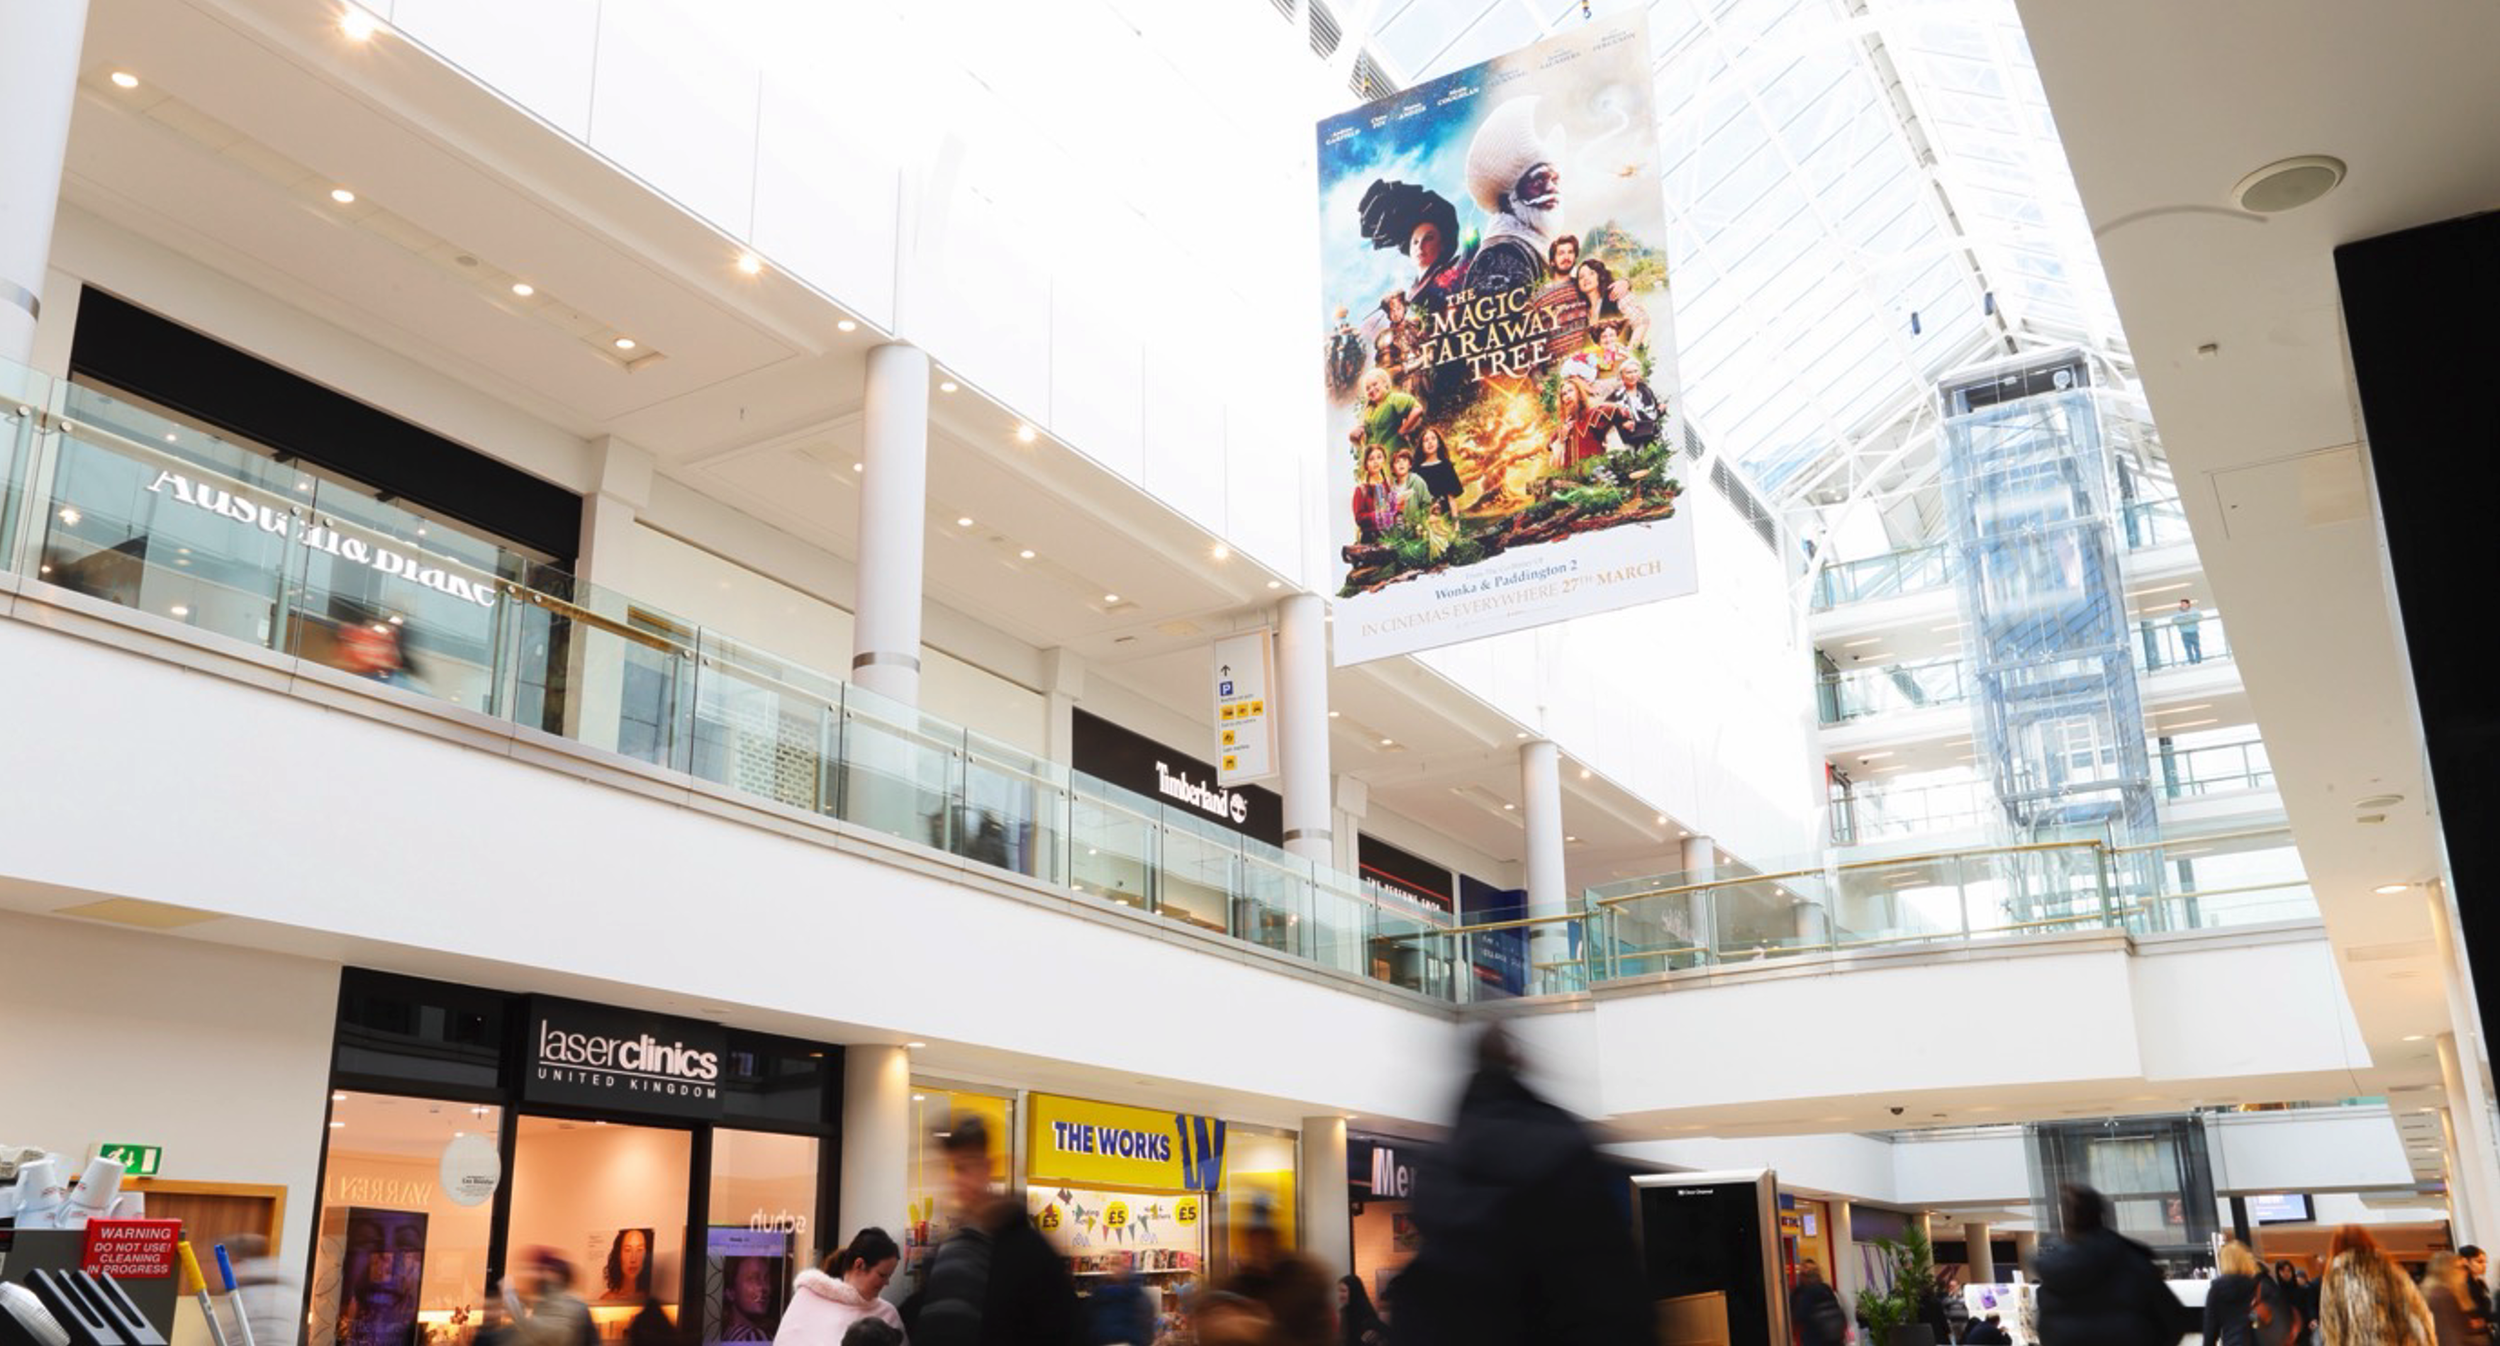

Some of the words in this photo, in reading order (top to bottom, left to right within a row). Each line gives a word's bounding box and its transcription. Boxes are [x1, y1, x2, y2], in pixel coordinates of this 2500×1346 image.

[1430, 287, 1530, 338] MAGIC
[1446, 288, 1476, 307] THE
[1419, 303, 1568, 371] FARAWAY
[1466, 338, 1552, 383] TREE
[1435, 583, 1477, 600] Wonka
[1480, 579, 1491, 591] &
[1494, 564, 1567, 588] Paddington
[1570, 559, 1578, 571] 2
[1361, 624, 1378, 637] IN
[1381, 607, 1450, 633] CINEMAS
[1453, 583, 1559, 618] EVERYWHERE
[1597, 560, 1663, 586] MARCH
[1156, 761, 1229, 818] Timberland
[539, 1019, 718, 1079] laserclinics
[538, 1068, 615, 1087] UNITED
[630, 1079, 716, 1099] KINGDOM
[1052, 1121, 1094, 1154] THE
[1095, 1126, 1171, 1162] WORKS
[1108, 1210, 1126, 1225] £5
[1178, 1206, 1197, 1221] £5
[93, 1242, 112, 1253] DO
[115, 1242, 140, 1253] NOT
[142, 1242, 172, 1253] USE!
[100, 1226, 172, 1240] WARNING
[86, 1263, 99, 1275] IN
[102, 1263, 169, 1275] PROGRESS
[99, 1253, 161, 1264] CLEANING
